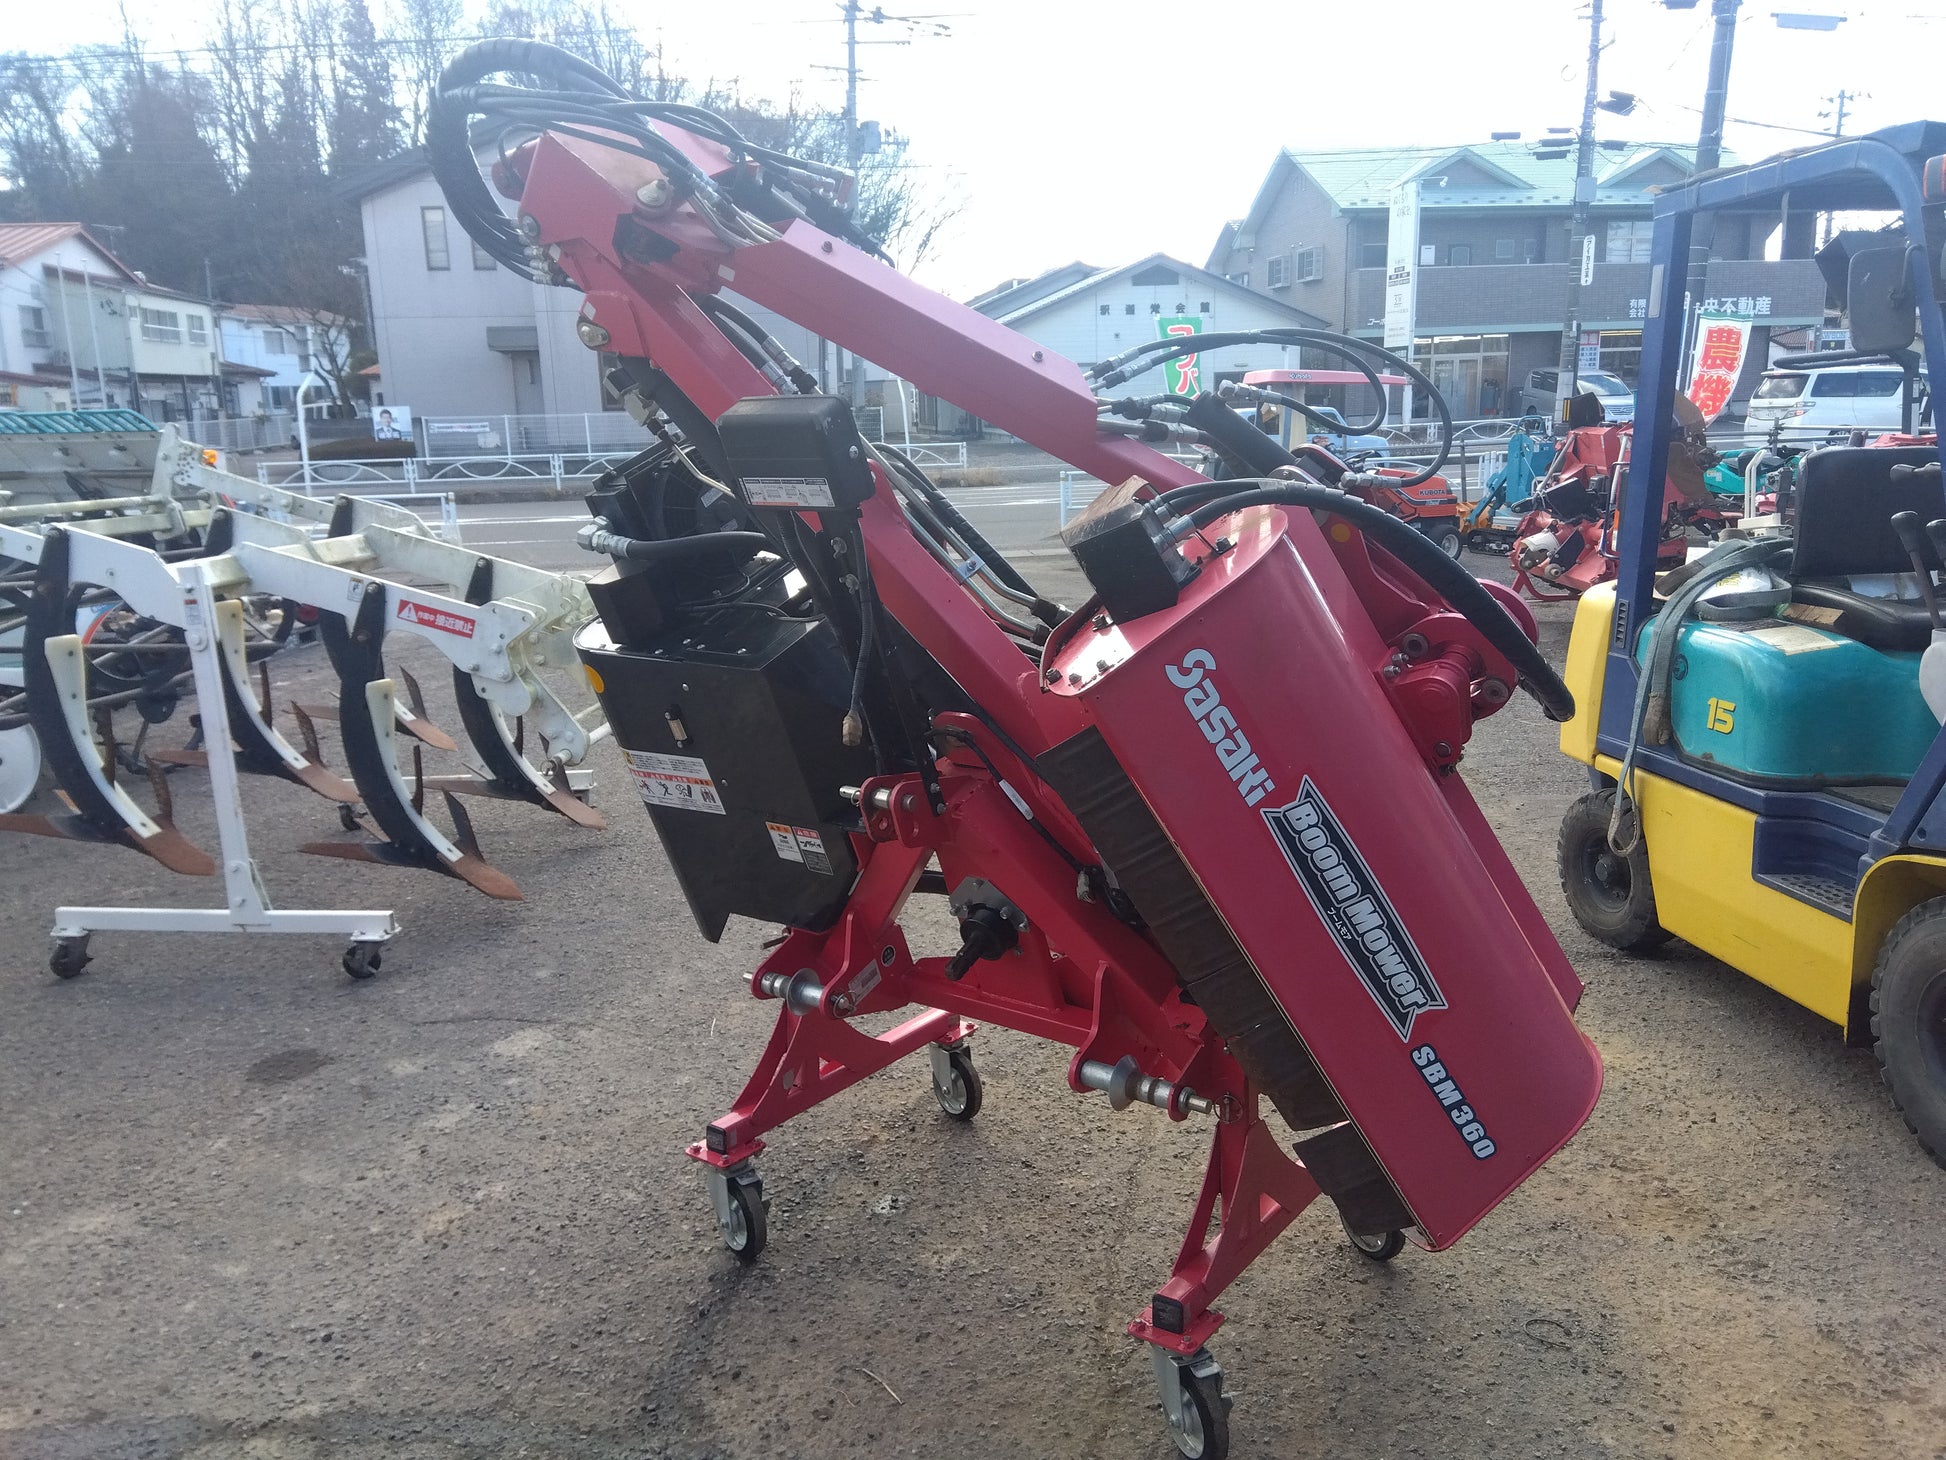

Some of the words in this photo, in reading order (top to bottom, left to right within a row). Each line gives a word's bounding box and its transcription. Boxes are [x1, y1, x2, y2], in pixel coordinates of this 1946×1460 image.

[1629, 299, 1647, 308] 有限
[1629, 309, 1646, 318] 会社
[1690, 325, 1742, 418] 農機
[1707, 697, 1736, 735] 15
[1285, 802, 1359, 901] Boom
[1345, 899, 1428, 1009] Mower
